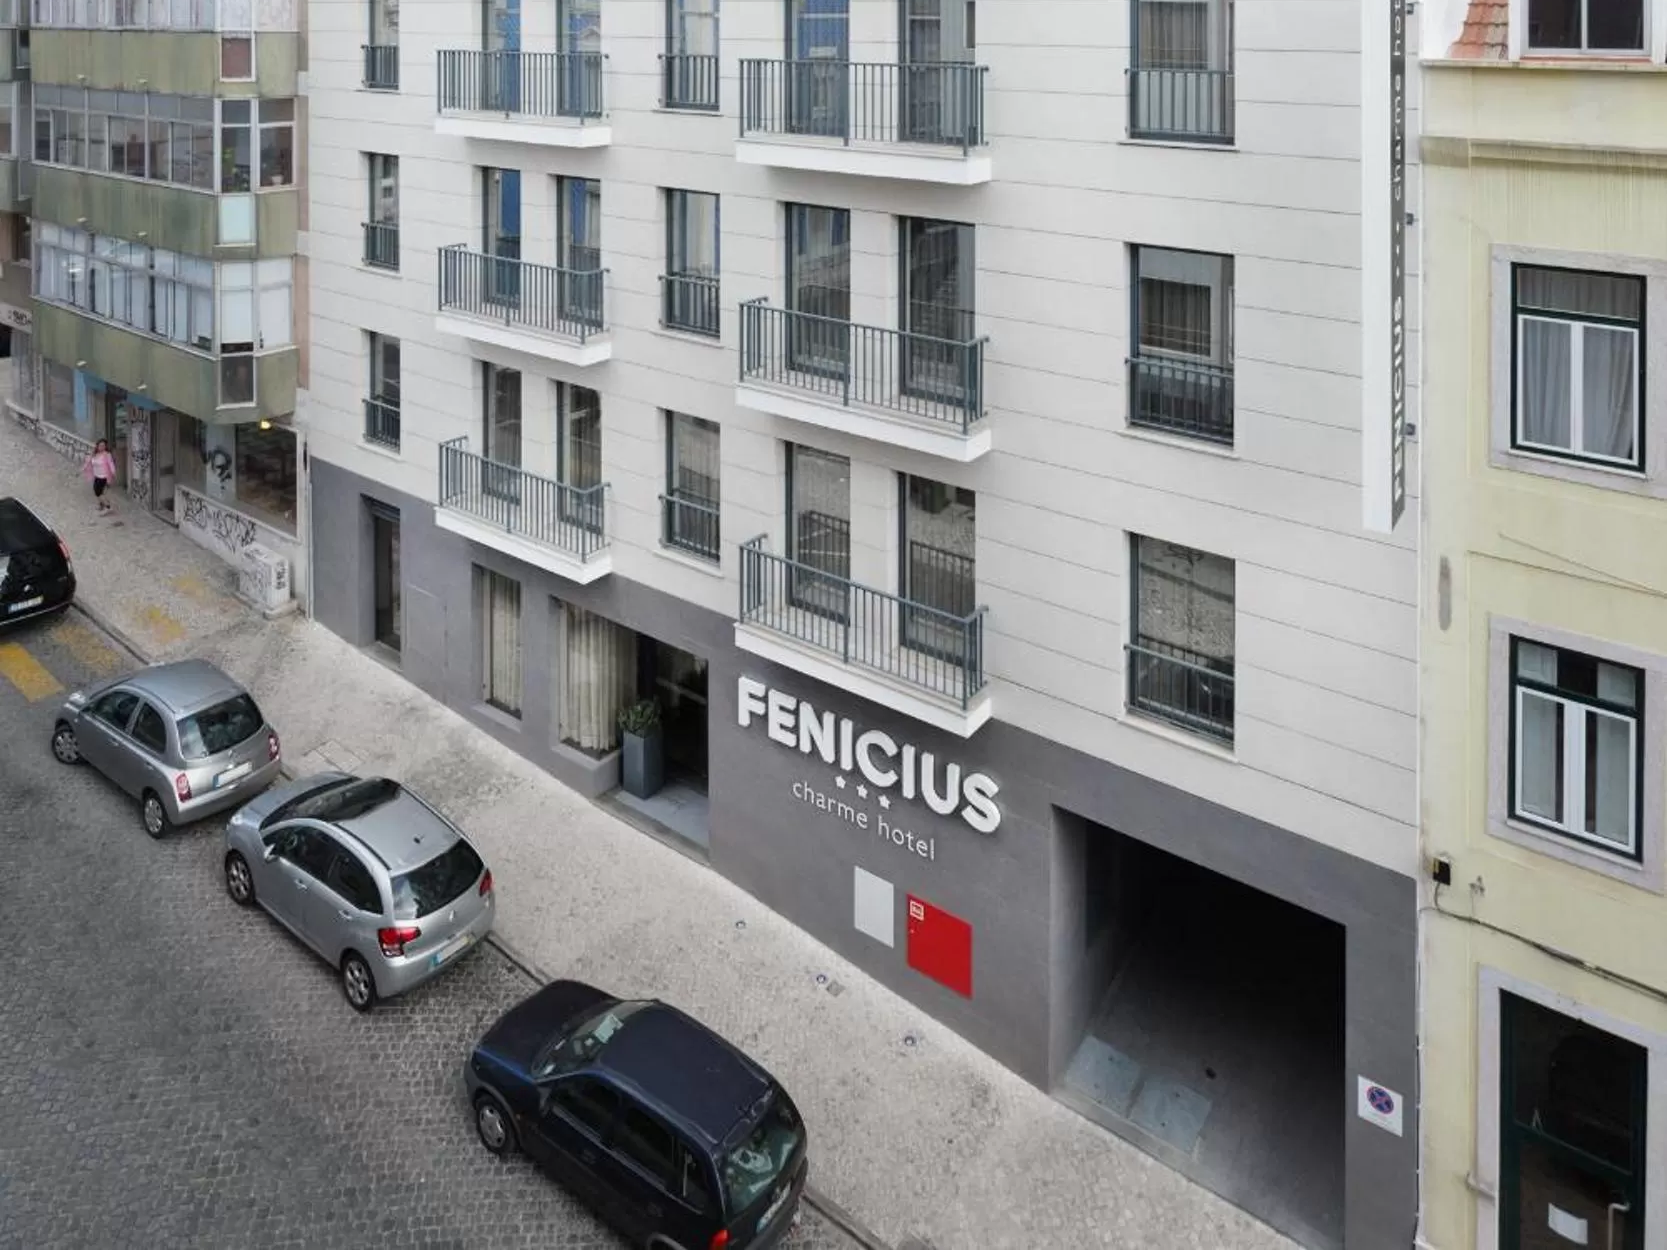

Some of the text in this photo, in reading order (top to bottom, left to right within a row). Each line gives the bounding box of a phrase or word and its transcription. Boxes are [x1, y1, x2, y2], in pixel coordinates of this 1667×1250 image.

[1393, 73, 1402, 202] charme
[1393, 296, 1403, 503] FENICIUS
[738, 676, 1001, 833] FENICIUS
[793, 781, 935, 861] charme hotel
